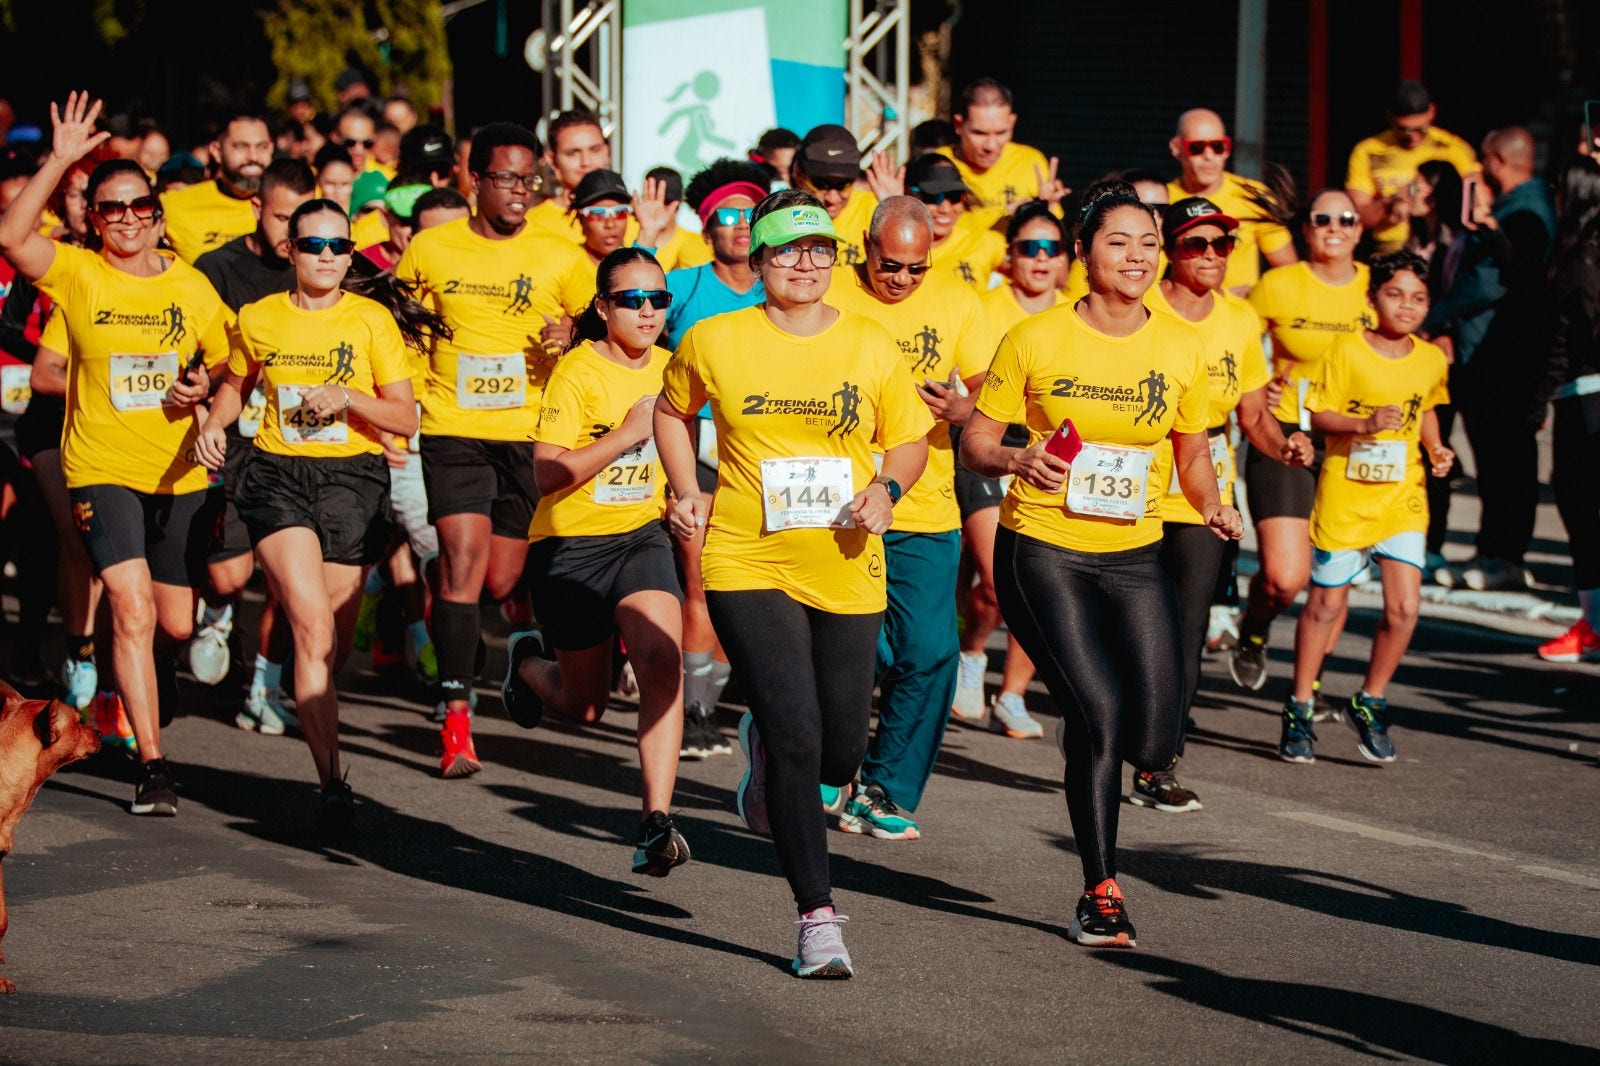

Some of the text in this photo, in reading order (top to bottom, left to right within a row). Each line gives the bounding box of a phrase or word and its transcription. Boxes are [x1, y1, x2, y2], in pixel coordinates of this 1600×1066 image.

[276, 353, 325, 361] TREINÃO
[123, 373, 166, 393] 196
[473, 377, 514, 394] 292
[1074, 383, 1135, 396] TREINÃO
[766, 398, 827, 408] TREINÃO
[1071, 391, 1145, 403] LAGOINHA
[765, 407, 838, 417] LAGOINHA
[1112, 403, 1144, 413] BETIM
[290, 409, 335, 428] 439
[805, 417, 836, 427] BETIM
[608, 463, 650, 486] 274
[1358, 463, 1395, 480] 057
[1084, 473, 1132, 499] 133
[779, 486, 833, 508] 144
